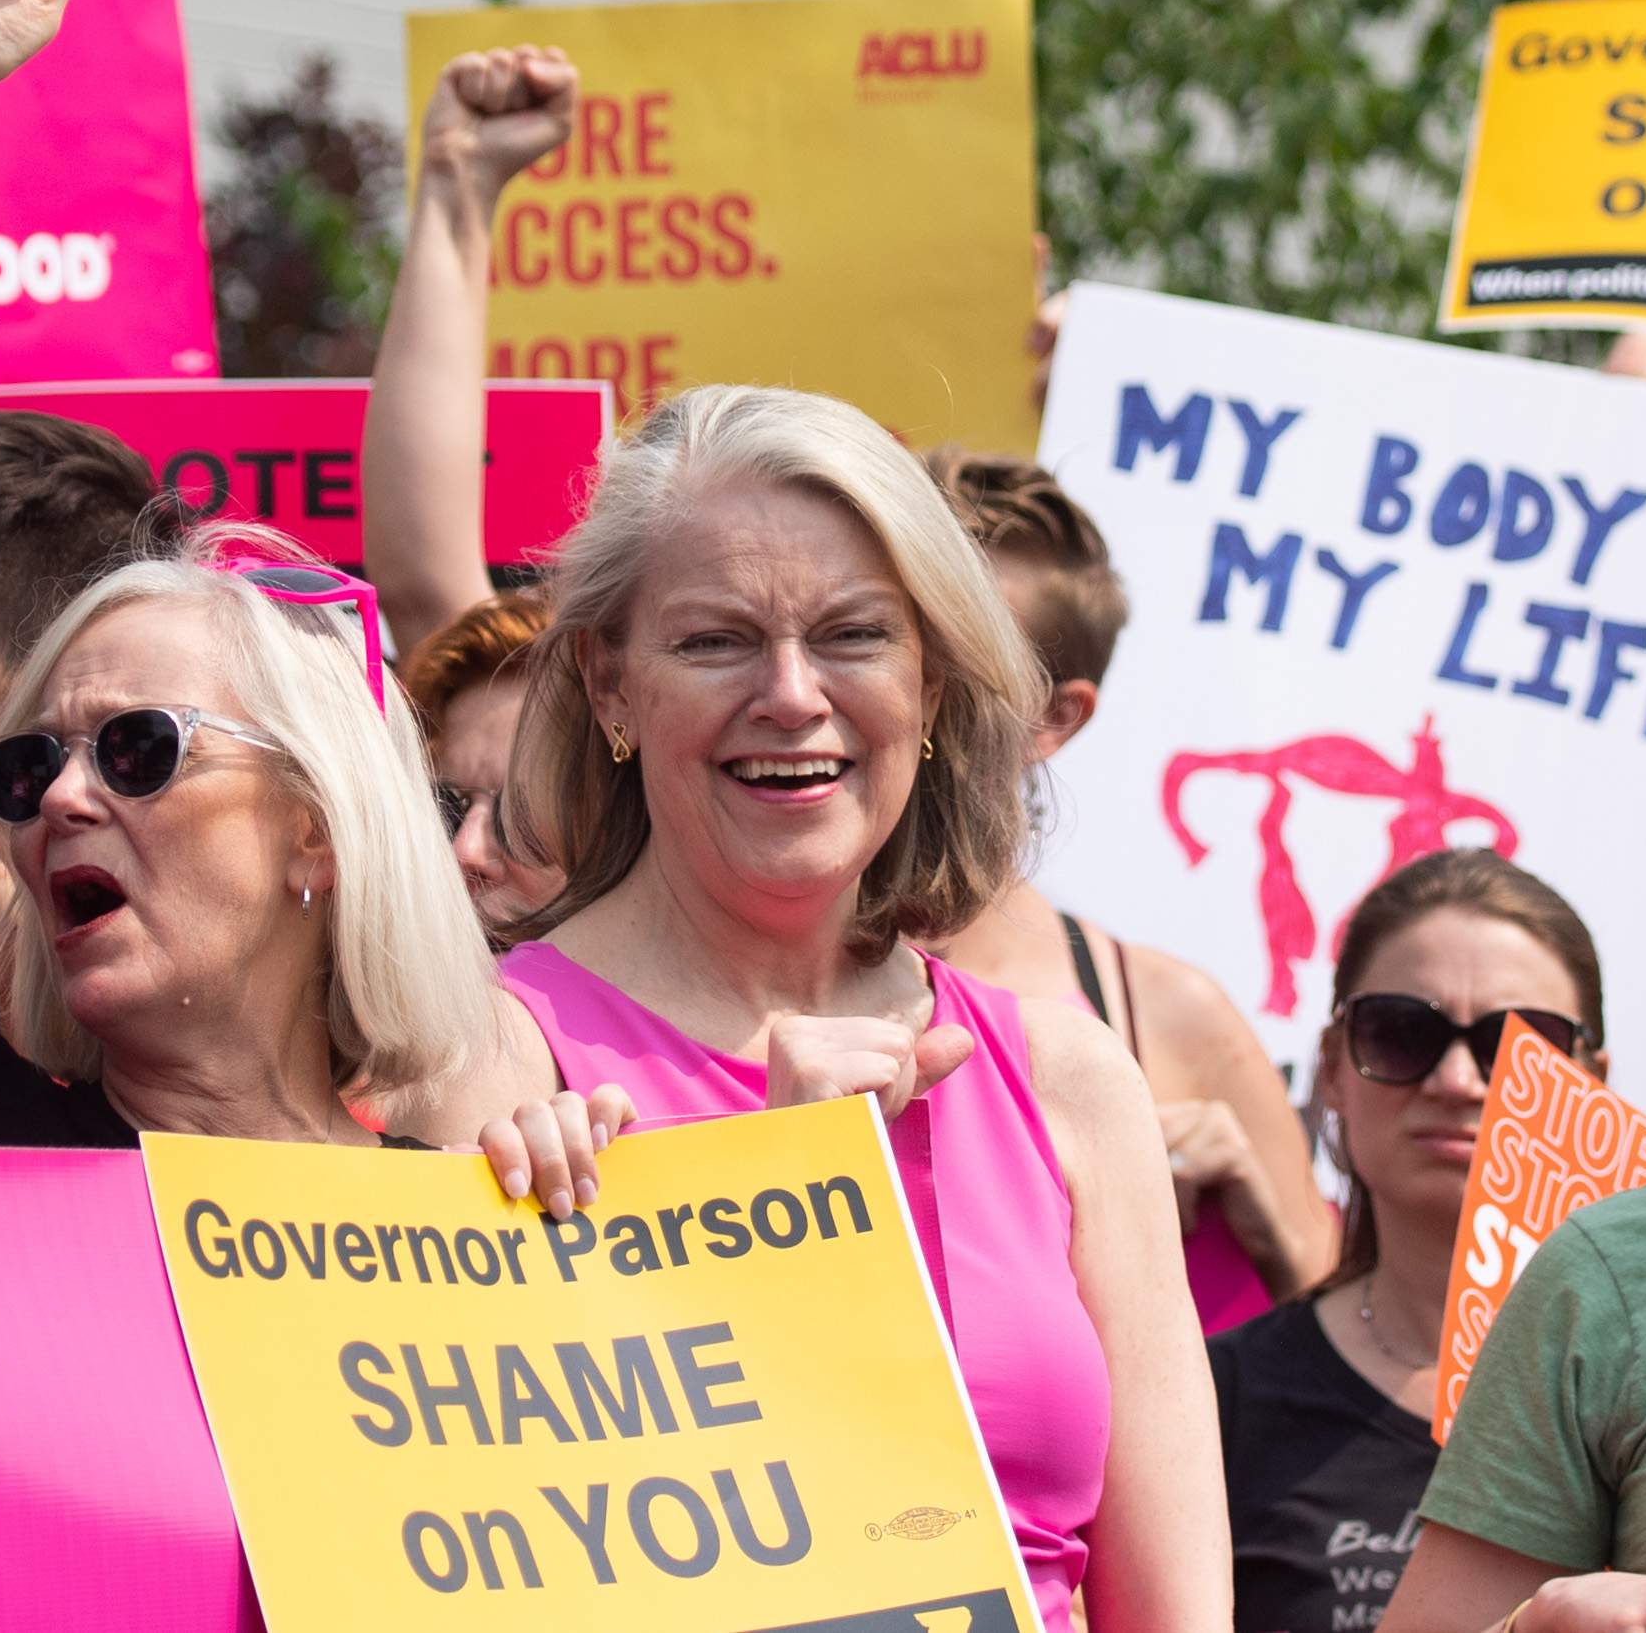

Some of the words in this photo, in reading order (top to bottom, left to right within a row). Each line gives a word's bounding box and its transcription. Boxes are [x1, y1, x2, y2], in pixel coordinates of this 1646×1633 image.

[857, 28, 989, 80] ACLU
[489, 193, 779, 288] CCESS.
[1113, 382, 1305, 498] MY
[1197, 522, 1400, 650] MY
[184, 1198, 529, 1287] Governor
[547, 1174, 874, 1285] Parson
[337, 1321, 763, 1448] SHAME
[401, 1508, 545, 1594] on
[538, 1459, 813, 1586] YOU
